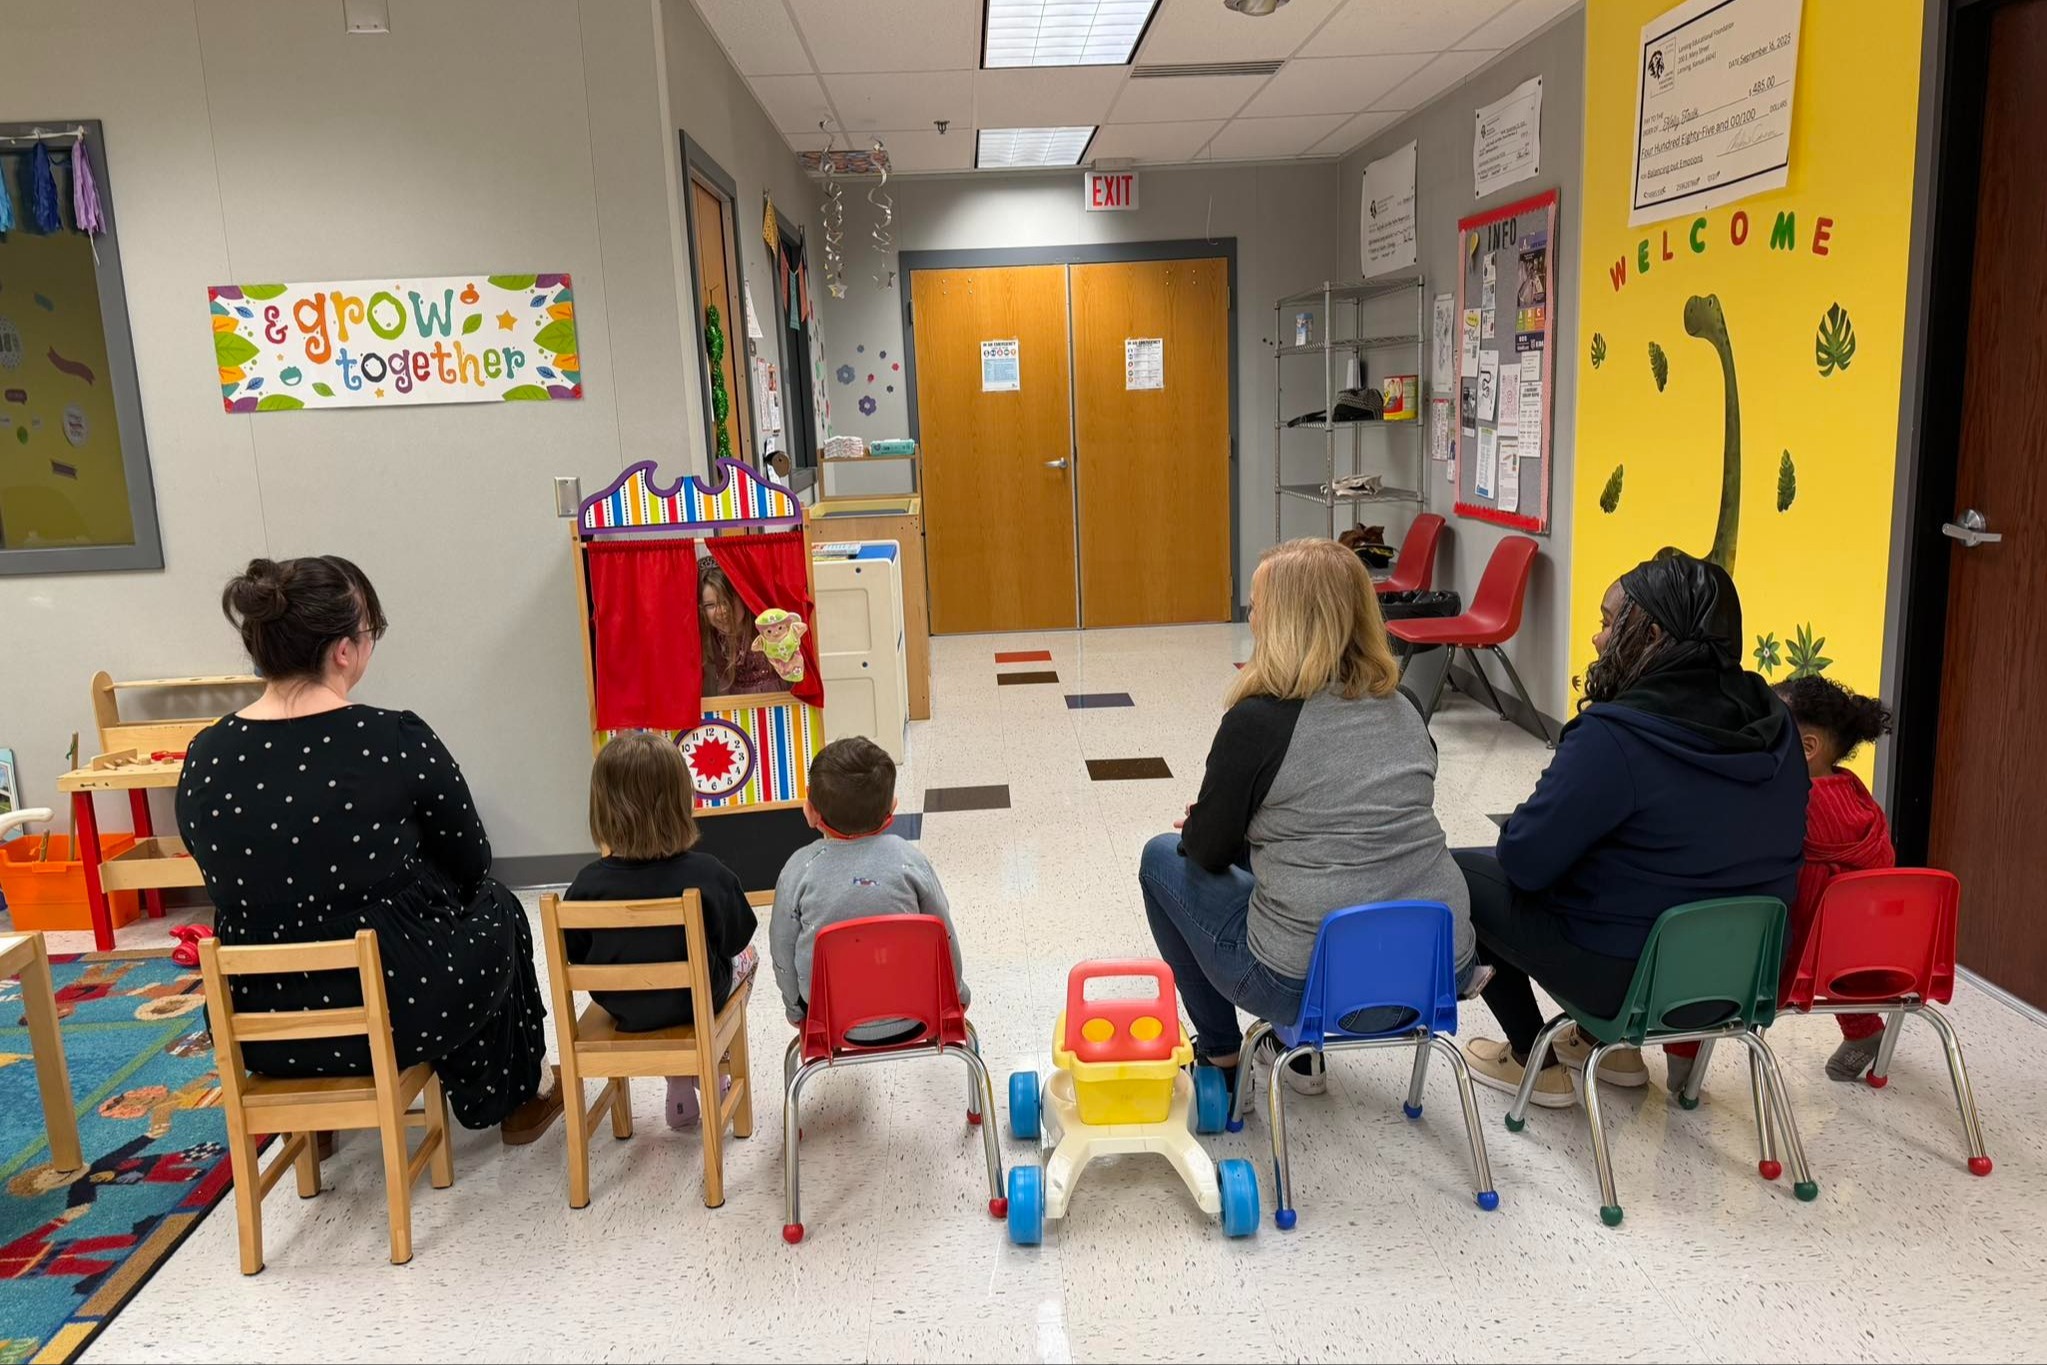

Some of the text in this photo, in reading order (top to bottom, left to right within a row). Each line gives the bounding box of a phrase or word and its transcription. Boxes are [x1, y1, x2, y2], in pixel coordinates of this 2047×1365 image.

[1740, 46, 1768, 64] September
[1776, 32, 1791, 49] 2025
[1752, 75, 1776, 94] 485.00
[1641, 147, 1654, 158] Four
[1654, 135, 1680, 153] Hundred
[1681, 125, 1715, 146] Eighty-Five
[1716, 120, 1729, 134] and
[1730, 108, 1756, 128] 00/100
[1648, 165, 1670, 179] Balancing
[1680, 154, 1703, 169] Emotions
[1092, 175, 1133, 206] EXIT
[1488, 218, 1516, 251] INFO
[1610, 211, 1834, 292] WELCOME
[264, 289, 454, 364] & grow
[336, 340, 525, 394] together
[693, 733, 699, 741] 11
[706, 728, 715, 737] 12
[682, 744, 690, 752] 10
[735, 740, 740, 749] 2
[739, 752, 744, 761] 3
[735, 766, 740, 775] 4
[698, 780, 702, 788] 7
[711, 782, 717, 790] 6
[727, 777, 733, 785] 5
